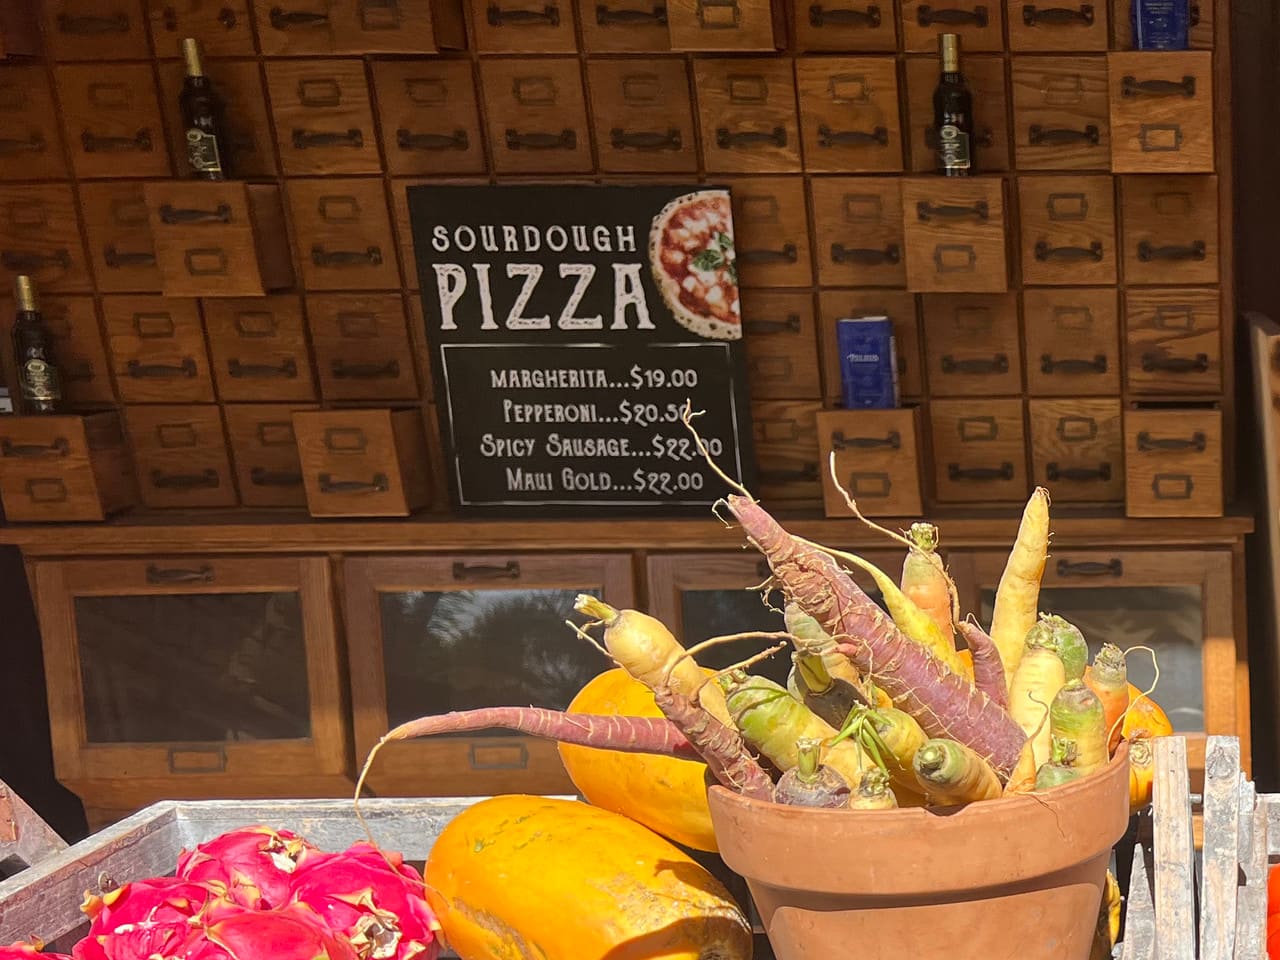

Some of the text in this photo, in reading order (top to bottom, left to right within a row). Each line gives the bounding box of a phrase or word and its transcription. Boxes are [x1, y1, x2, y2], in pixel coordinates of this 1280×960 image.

[431, 224, 638, 253] SOURDOUGH
[432, 263, 657, 330] PIZZA
[480, 433, 536, 458] SPICY
[505, 467, 553, 491] MAUI
